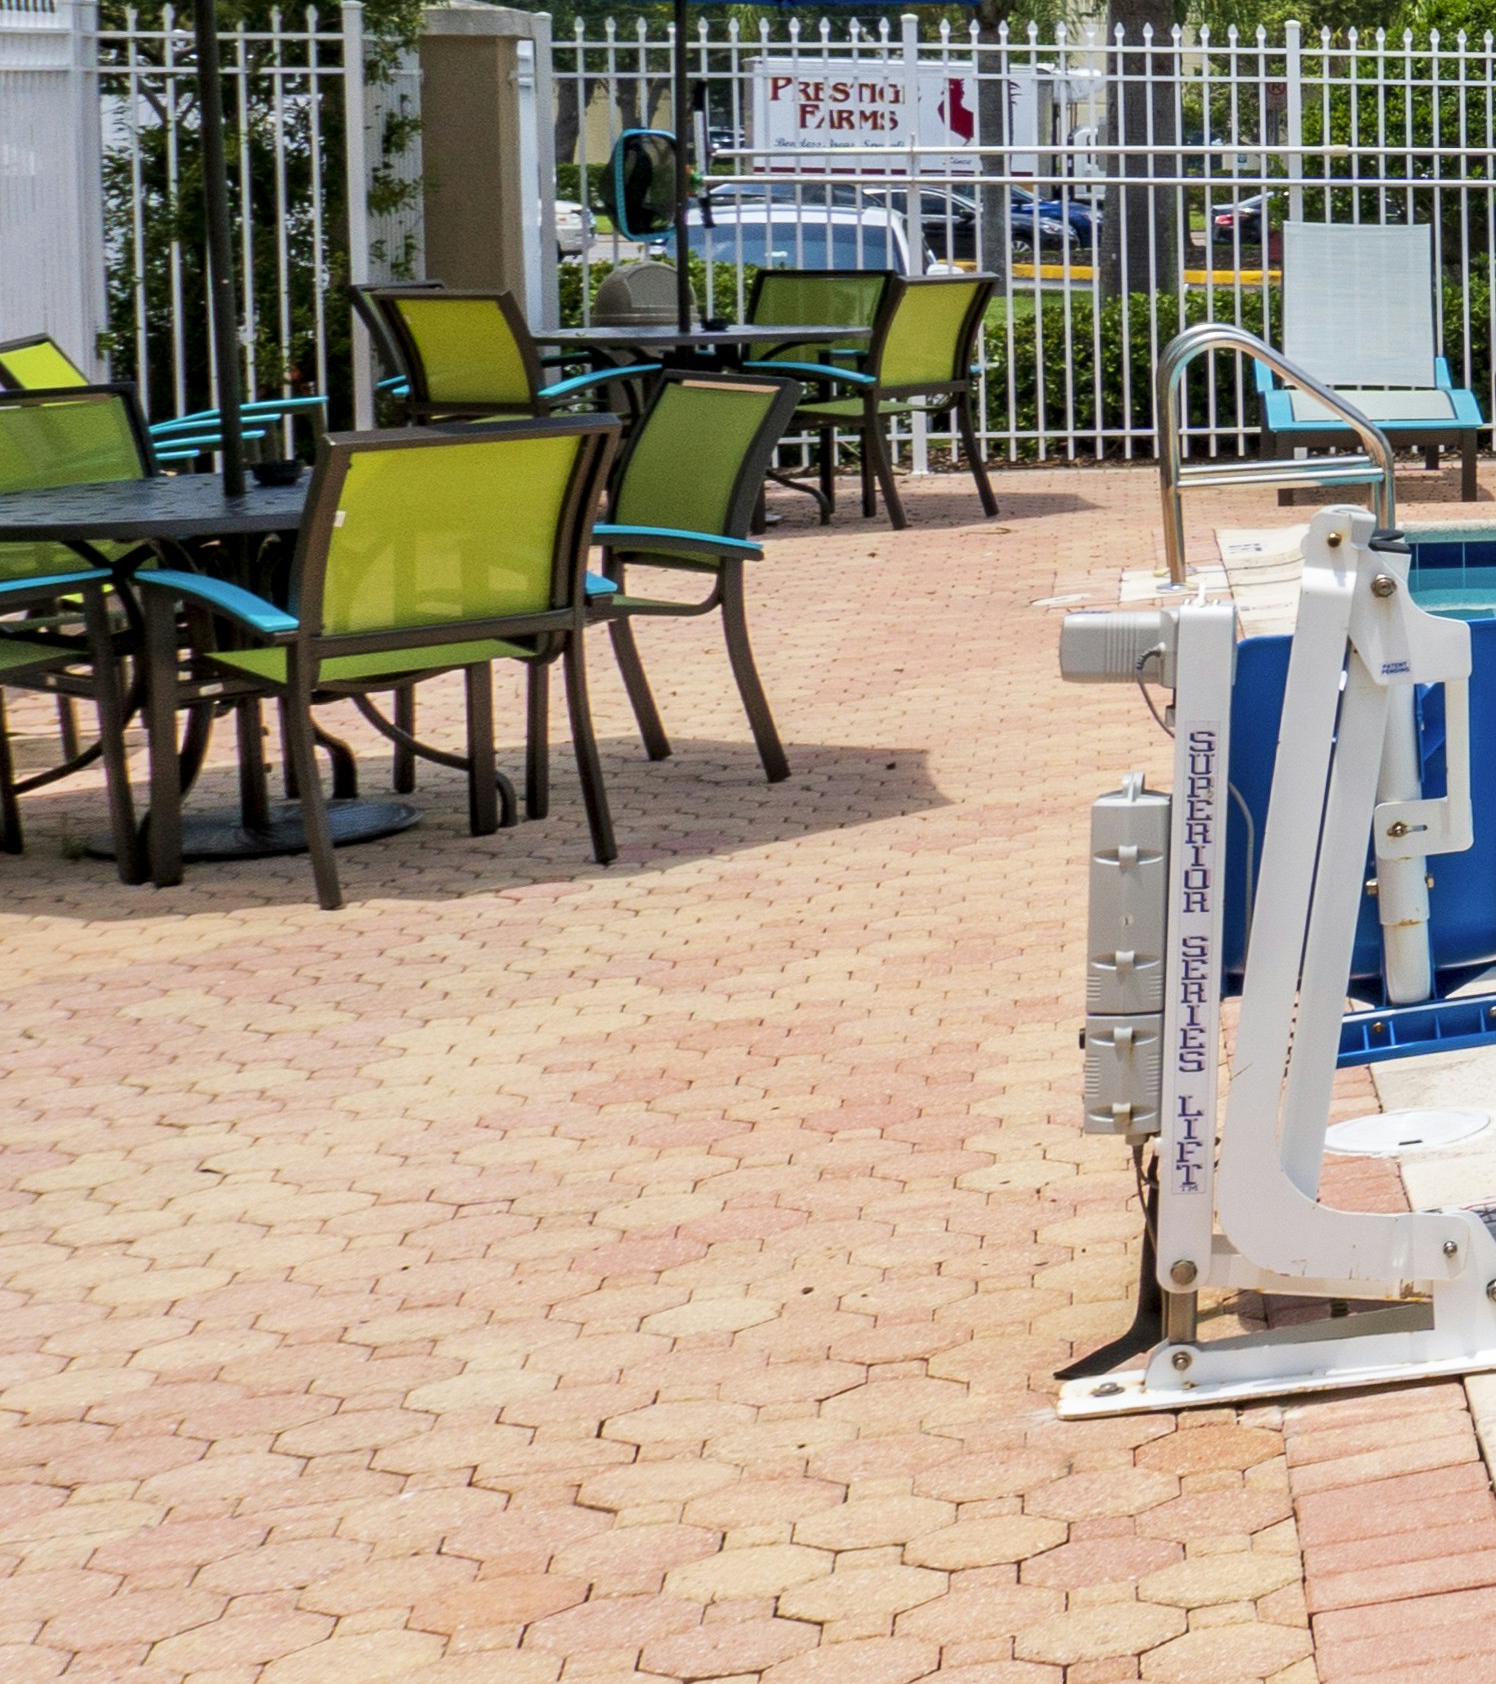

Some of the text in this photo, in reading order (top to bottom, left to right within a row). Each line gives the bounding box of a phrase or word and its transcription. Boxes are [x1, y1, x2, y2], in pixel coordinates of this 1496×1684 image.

[798, 103, 899, 131] FARMS
[1381, 667, 1410, 675] PENDING
[1382, 661, 1407, 669] PATENT
[1182, 730, 1217, 914] SUPERIOR
[1178, 935, 1210, 1073] SERIES
[1176, 1094, 1204, 1186] LIFT
